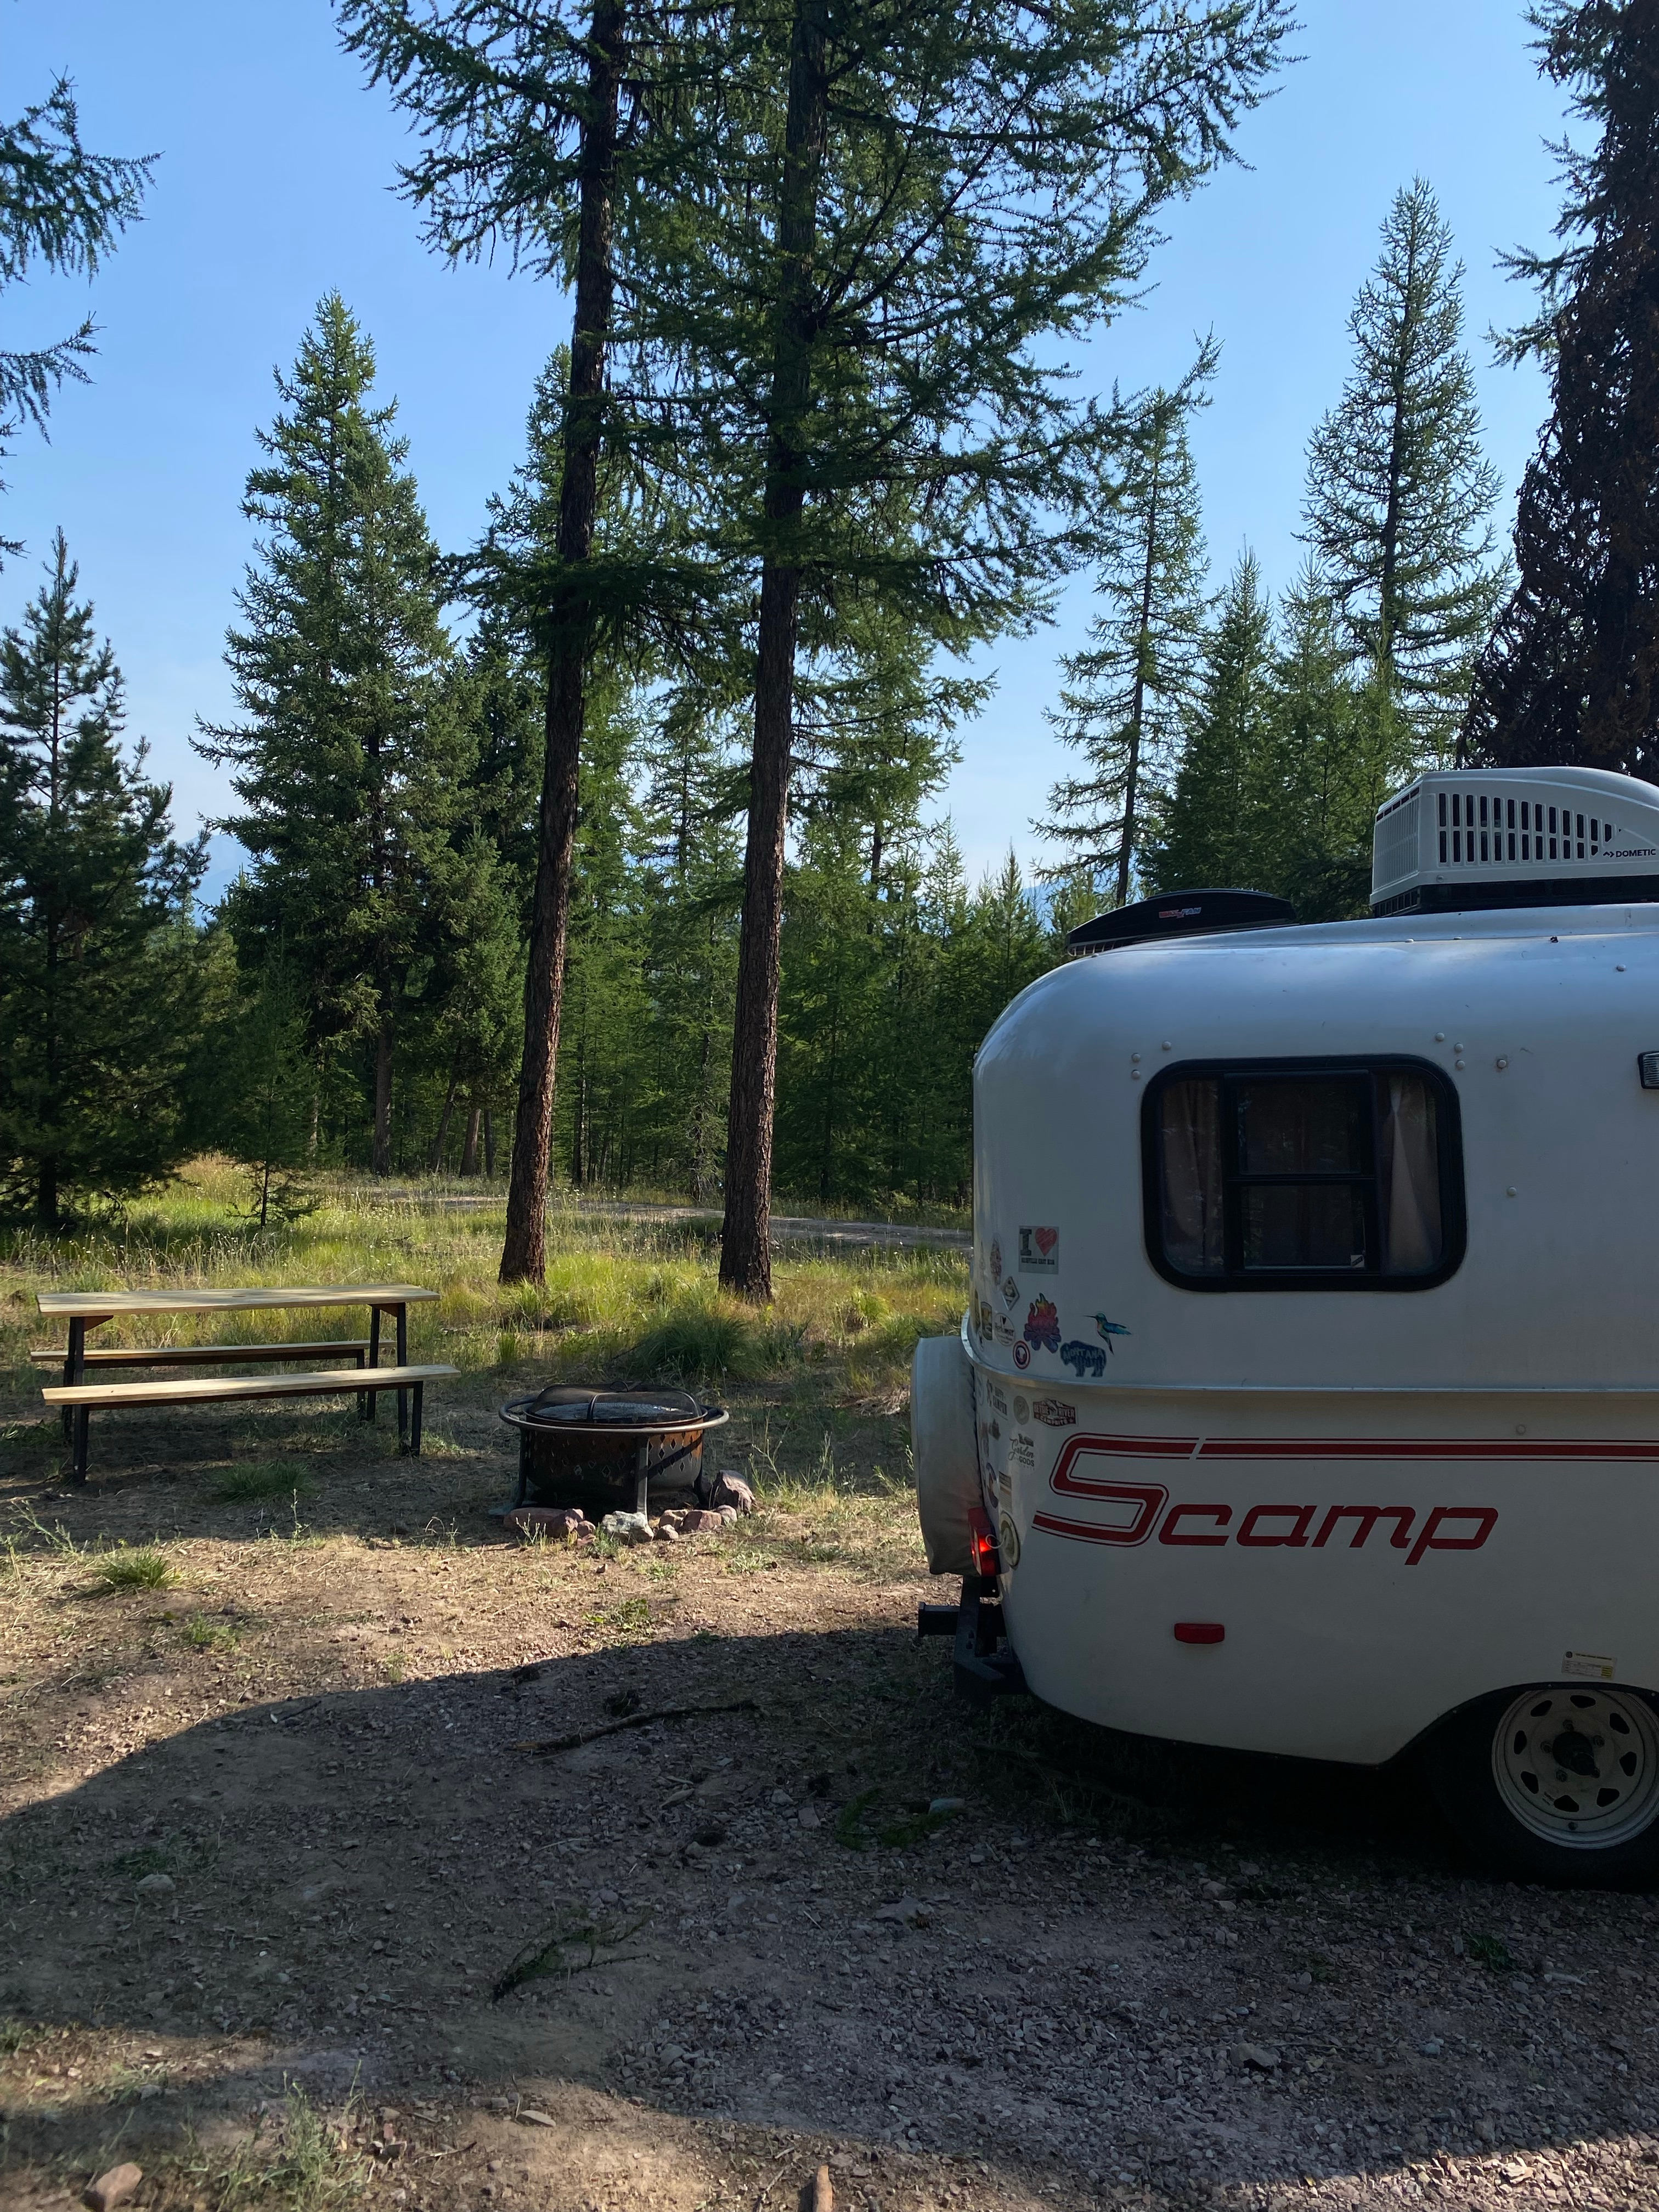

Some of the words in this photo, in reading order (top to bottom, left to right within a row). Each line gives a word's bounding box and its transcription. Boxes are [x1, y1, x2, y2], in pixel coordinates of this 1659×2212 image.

[1616, 849, 1656, 857] DOMETIC
[1020, 1228, 1032, 1256] I
[1058, 1407, 1075, 1418] RIVER
[1019, 1456, 1035, 1467] GODS
[1031, 1432, 1499, 1565] Scamp
